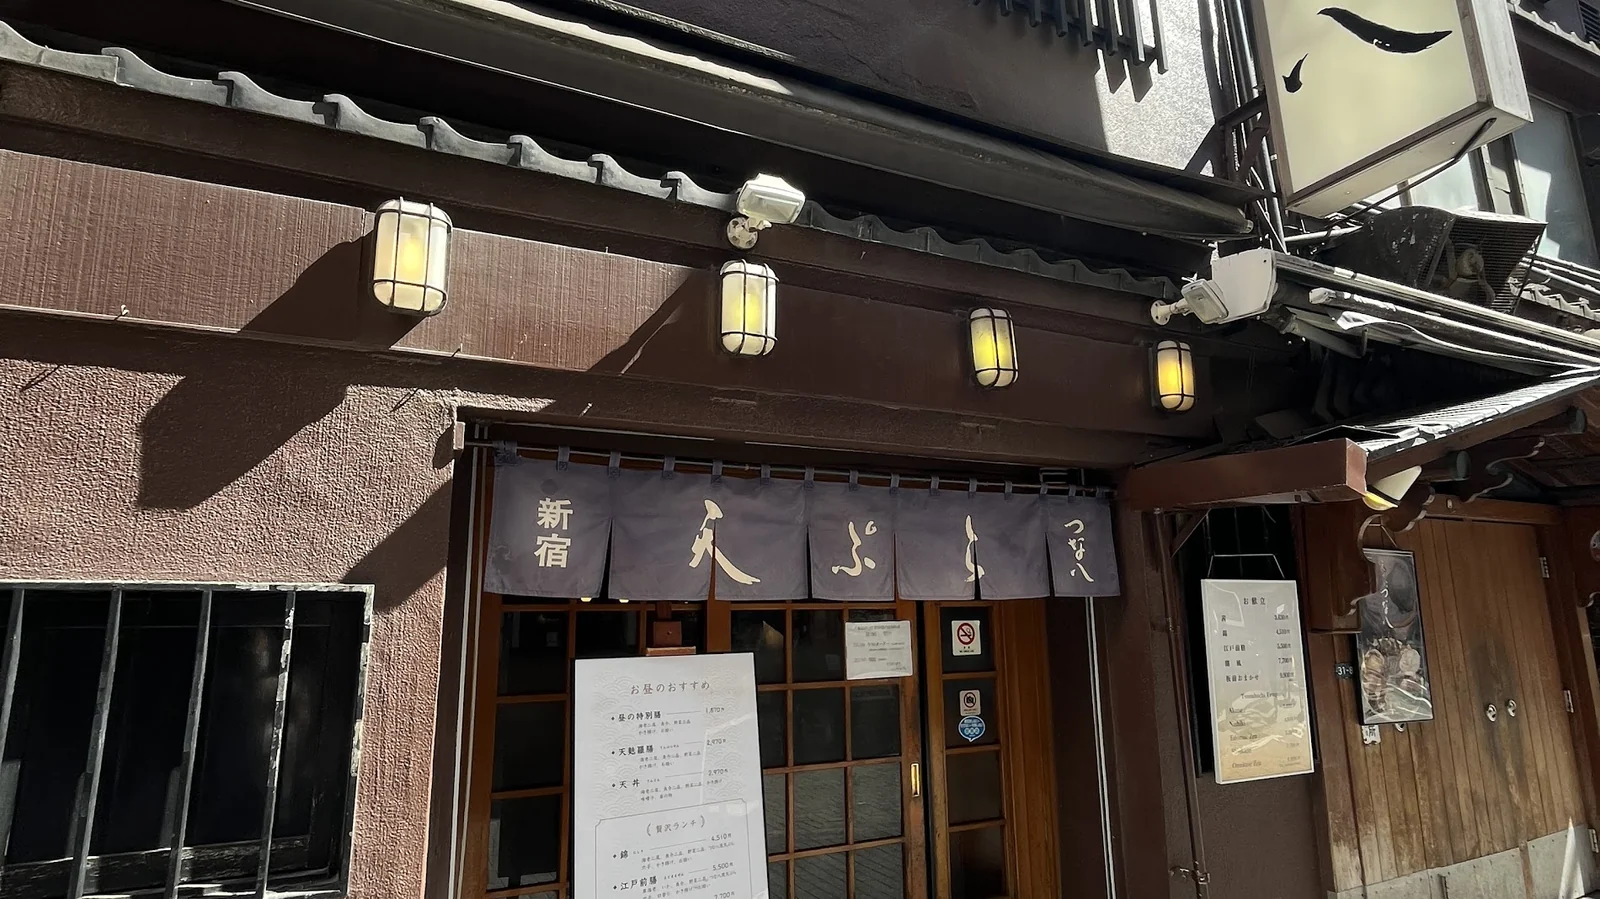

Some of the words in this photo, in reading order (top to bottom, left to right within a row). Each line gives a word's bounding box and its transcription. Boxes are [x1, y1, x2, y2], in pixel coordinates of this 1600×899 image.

[533, 497, 574, 568] 新宿
[1064, 518, 1094, 583] つな八
[1337, 666, 1353, 676] 31-8
[630, 680, 711, 696] お昼のおすすめ
[618, 710, 661, 722] 昼の特別膳
[619, 778, 640, 789] 天丼
[619, 849, 629, 860] 錦
[620, 875, 658, 891] 江戸前膳
[712, 861, 734, 871] 5,500円
